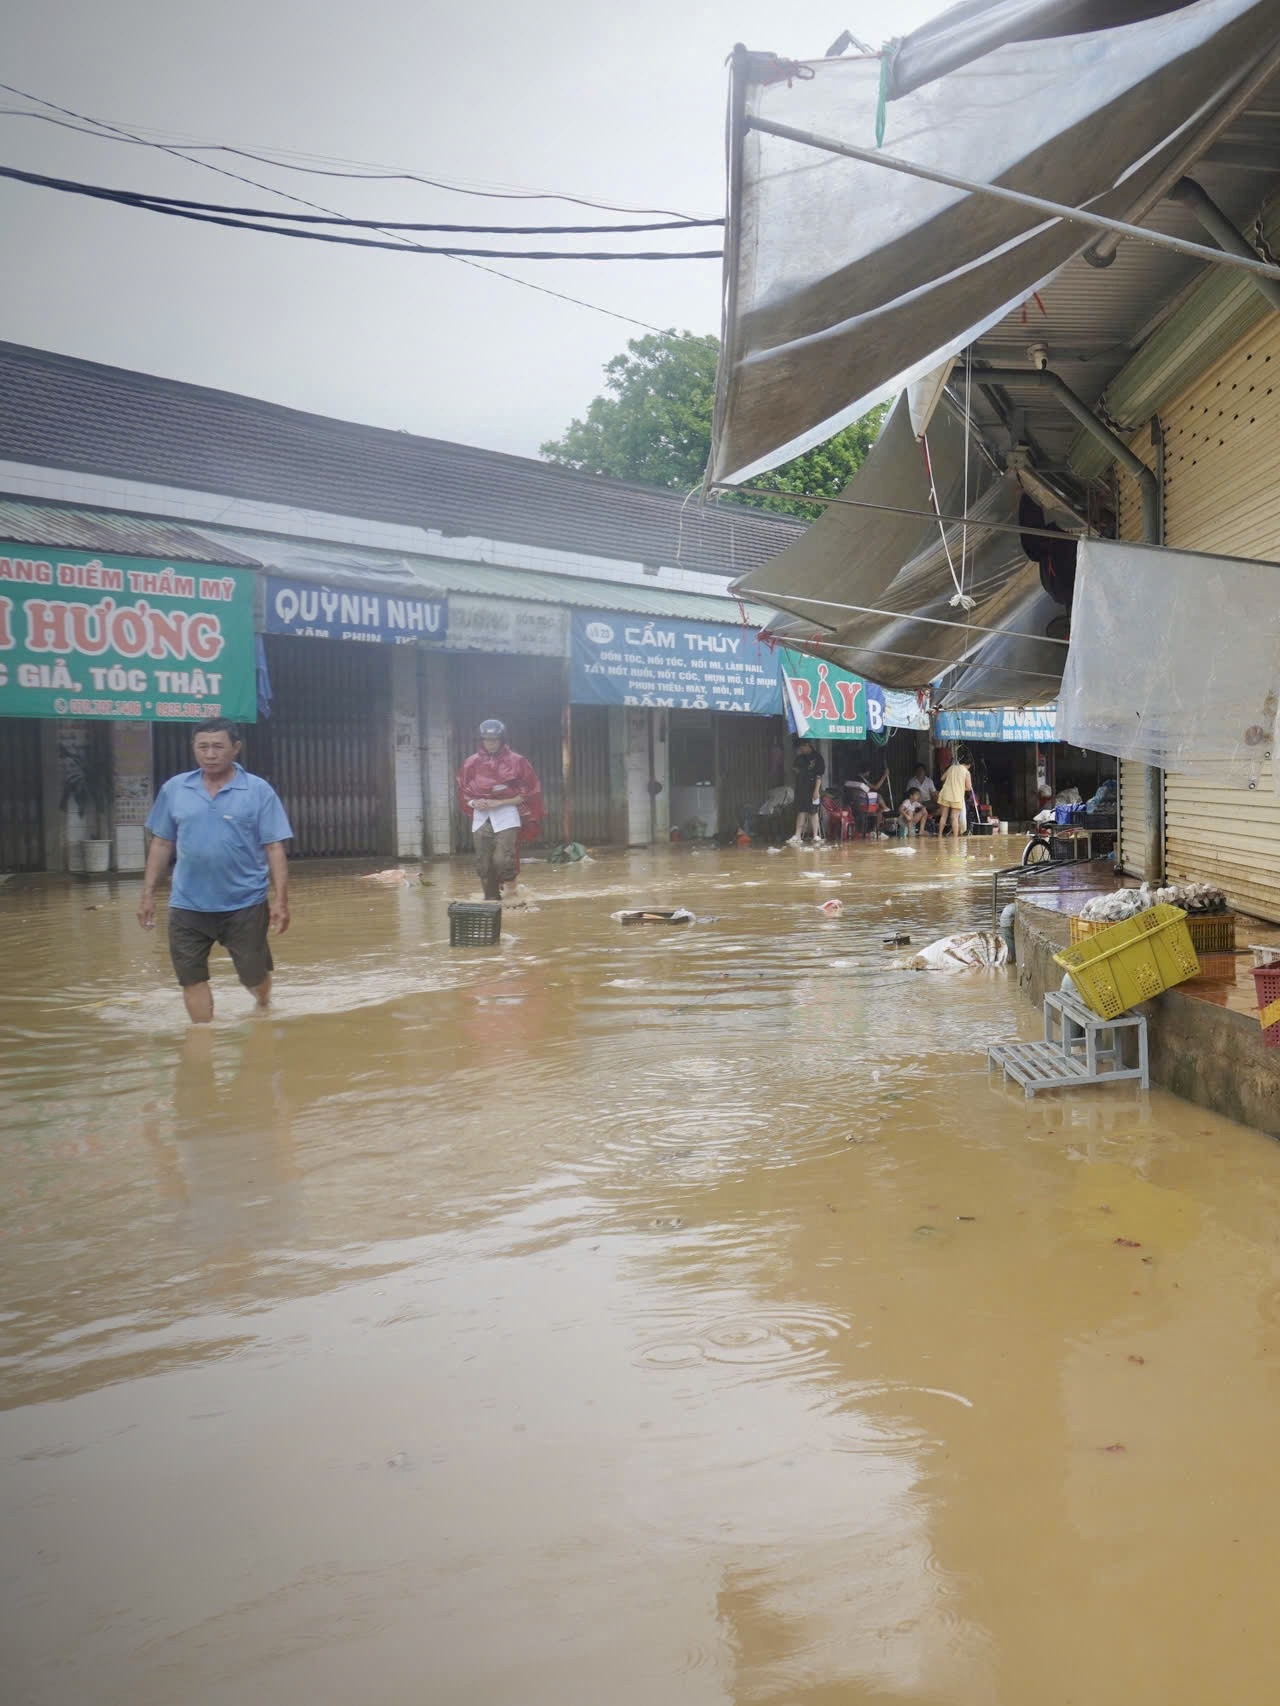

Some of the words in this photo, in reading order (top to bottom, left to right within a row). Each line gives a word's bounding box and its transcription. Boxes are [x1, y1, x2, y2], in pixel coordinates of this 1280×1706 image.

[57, 560, 123, 591] ĐIỂM
[128, 568, 195, 598] THẨM
[200, 577, 235, 601] MỸ
[275, 585, 380, 627] QUỲNH
[24, 596, 224, 662] HƯƠNG
[683, 633, 741, 654] THÚY
[17, 658, 82, 692] GIẢ,
[89, 664, 147, 692] TÓC
[154, 668, 222, 699] THẬT
[715, 700, 752, 712] TAI
